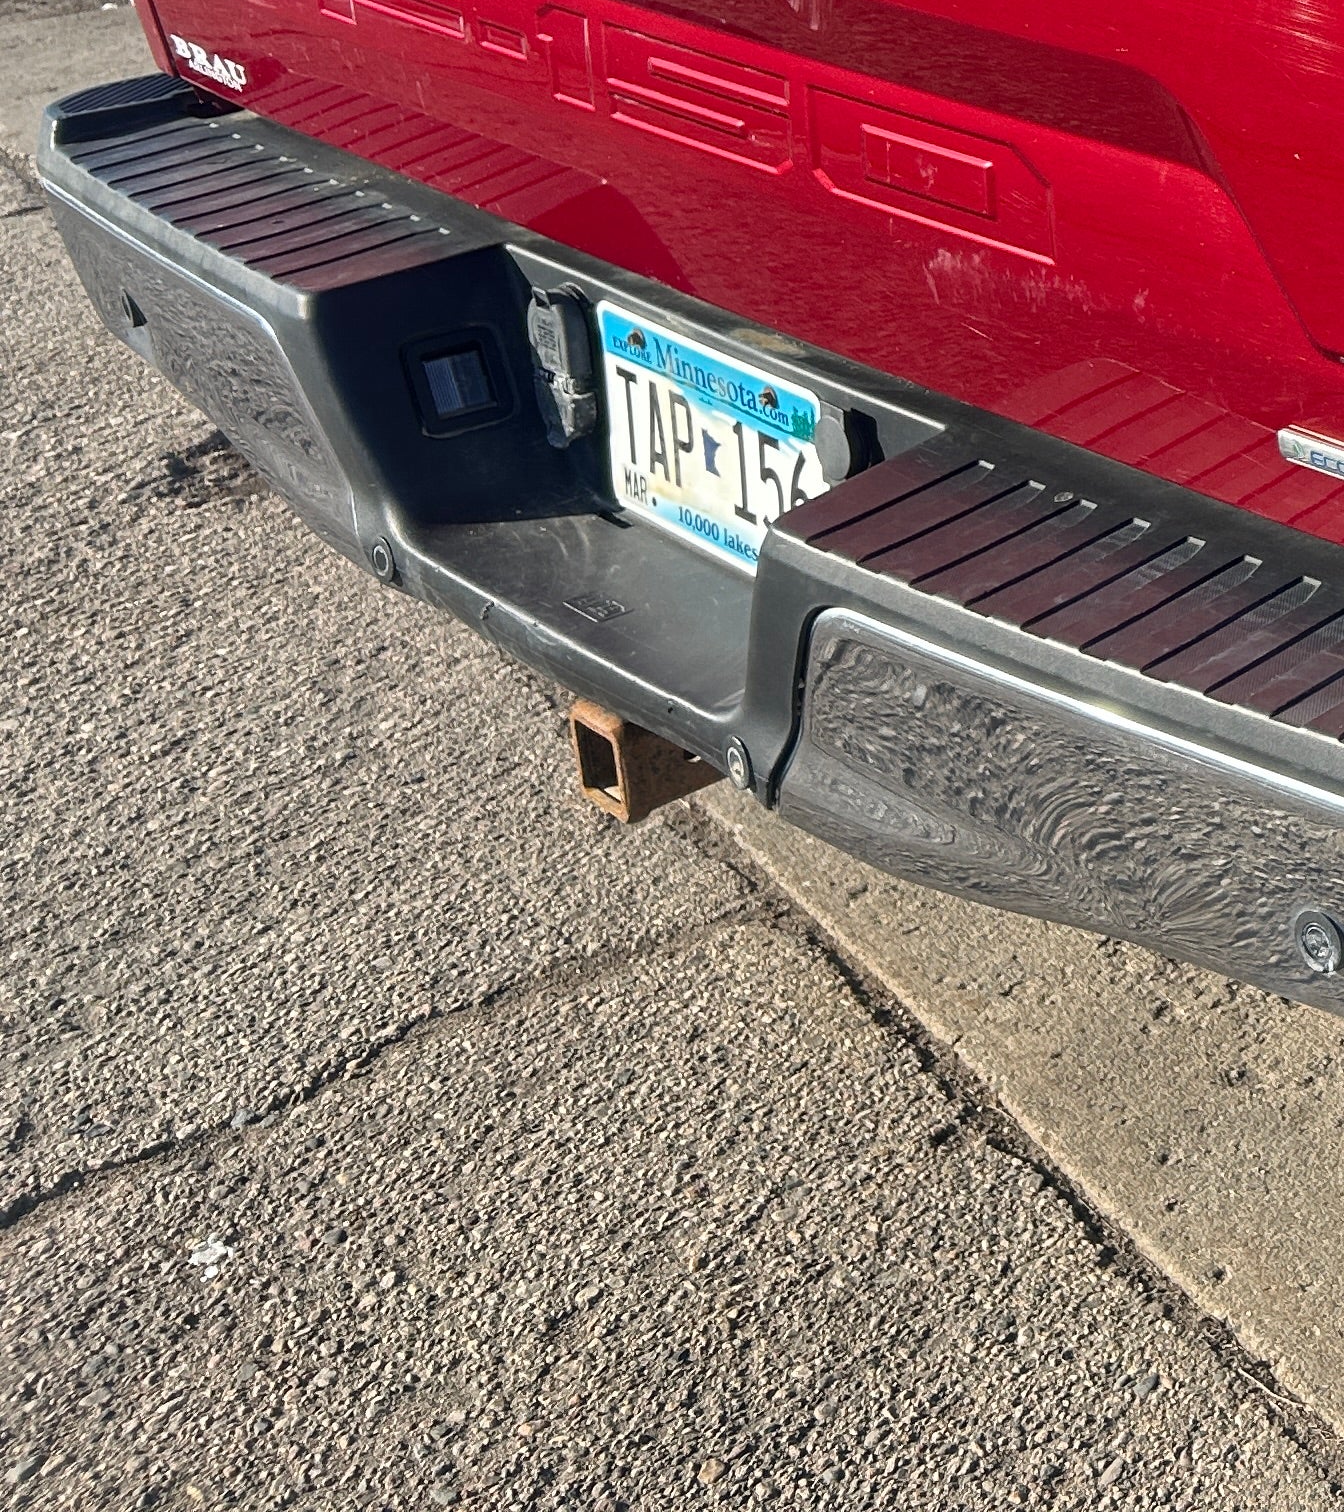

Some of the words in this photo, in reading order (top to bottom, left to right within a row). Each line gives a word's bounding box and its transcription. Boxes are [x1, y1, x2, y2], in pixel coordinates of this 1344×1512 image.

[170, 34, 247, 86] BRAU
[616, 365, 694, 487] TAP
[624, 467, 649, 505] MAR
[678, 506, 720, 541] 10,000
[723, 527, 759, 562] lakes
